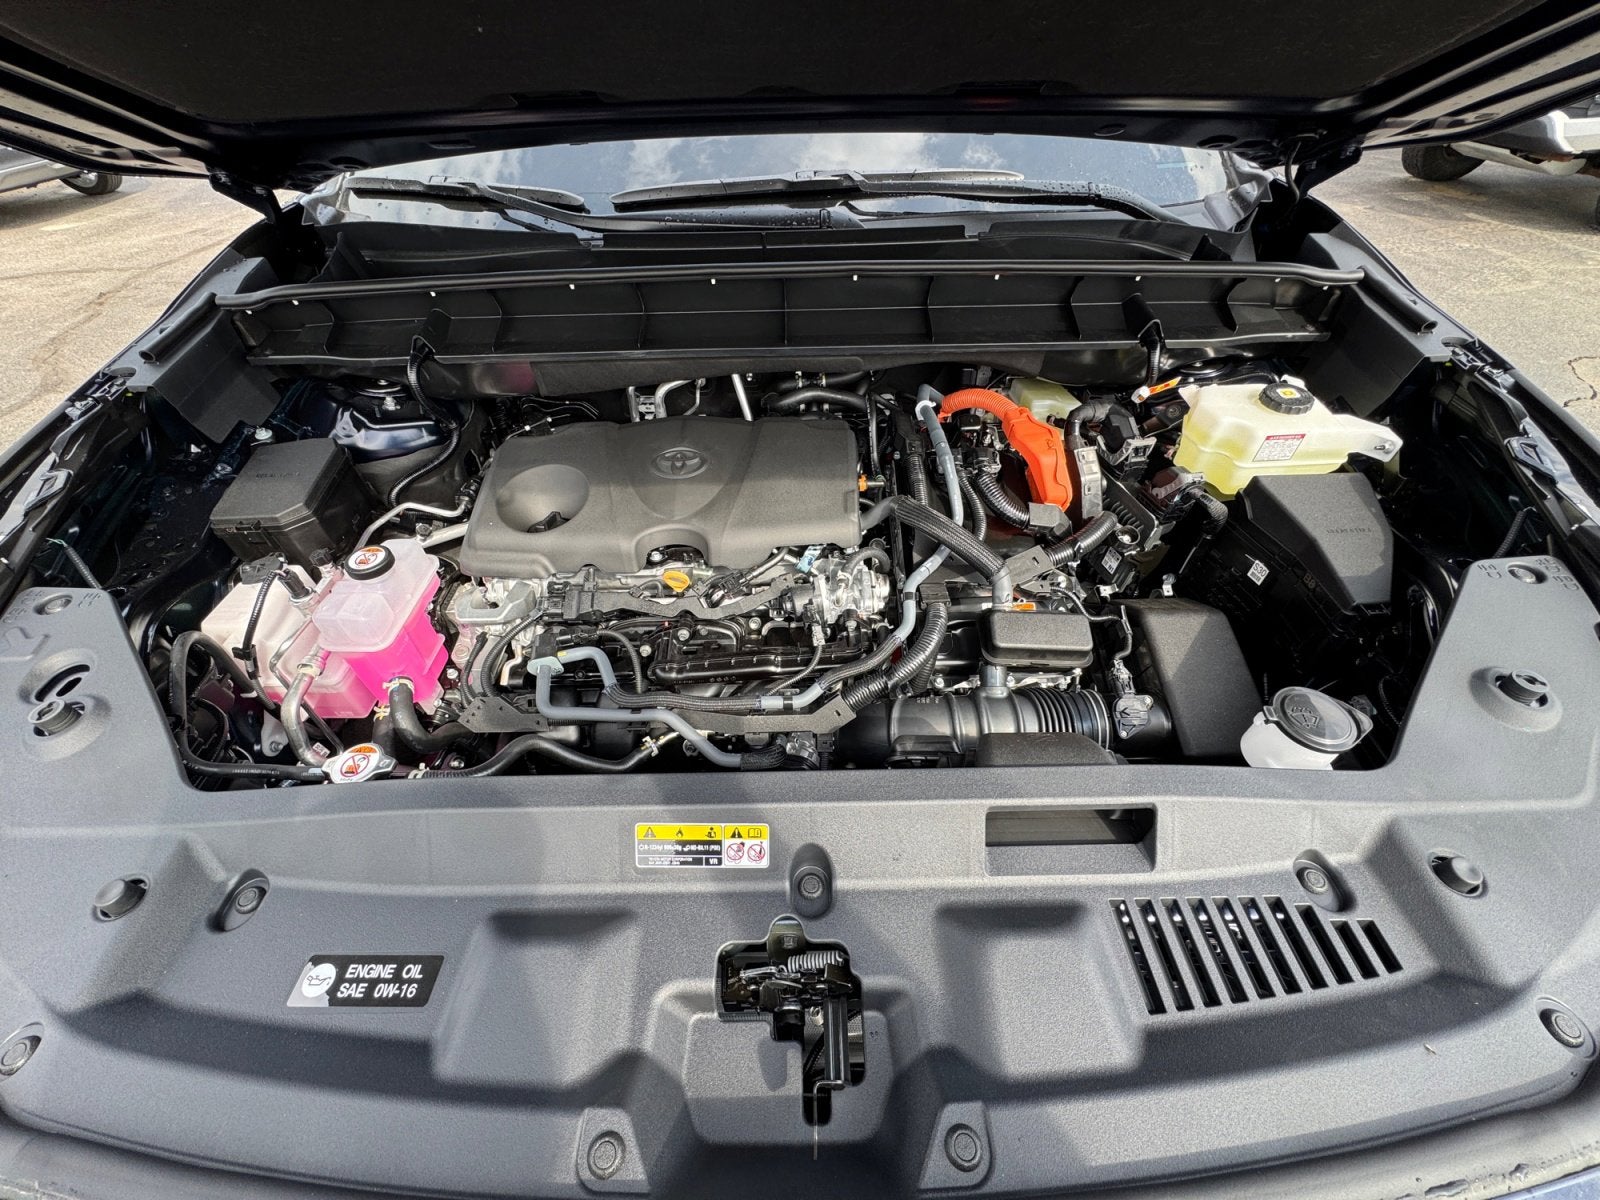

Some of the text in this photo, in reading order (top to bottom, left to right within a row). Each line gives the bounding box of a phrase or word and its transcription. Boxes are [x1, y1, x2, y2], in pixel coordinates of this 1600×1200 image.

[1253, 563, 1267, 577] S30
[344, 963, 423, 978] ENGINE OIL
[337, 983, 418, 998] SAE 0W-16
